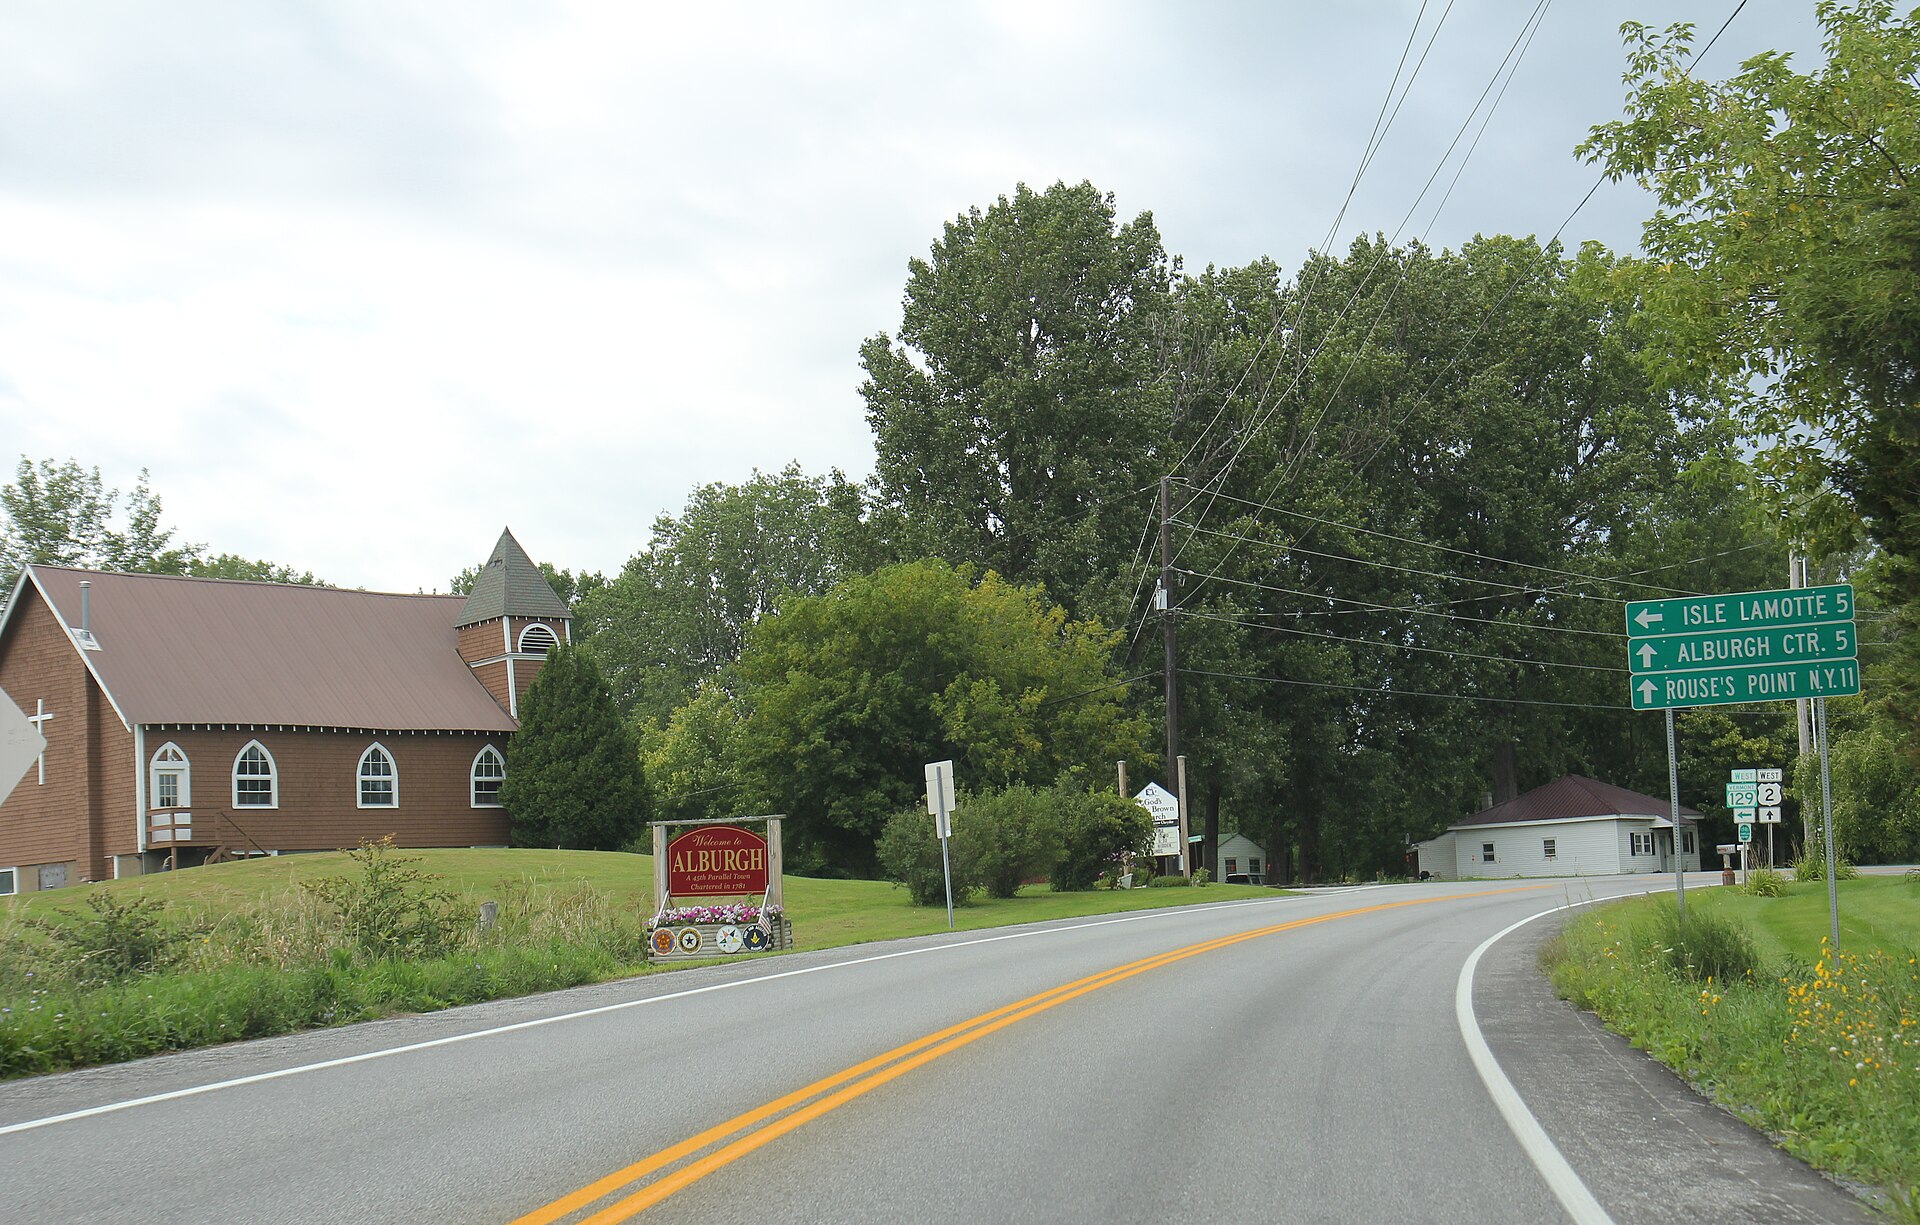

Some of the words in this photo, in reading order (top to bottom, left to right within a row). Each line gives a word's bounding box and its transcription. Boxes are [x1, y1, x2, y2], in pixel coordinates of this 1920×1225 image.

[1683, 603, 1727, 625] ISLE
[1739, 594, 1828, 621] LAMOTTE
[1836, 593, 1849, 613] 5
[1677, 636, 1770, 663] ALBURGH
[1782, 632, 1826, 655] CTR.
[1835, 630, 1848, 651] 5
[1666, 676, 1735, 700] ROUSE'S
[1748, 671, 1797, 695] POINT
[1760, 771, 1779, 779] WEST
[1729, 792, 1754, 805] 129
[1765, 788, 1774, 801] 2
[1144, 798, 1162, 806] God's
[1152, 805, 1175, 813] Brown
[692, 834, 731, 847] Welcome
[733, 837, 742, 846] to
[672, 848, 763, 873] ALBURGH
[692, 874, 706, 882] 45th
[690, 883, 723, 891] Chartered
